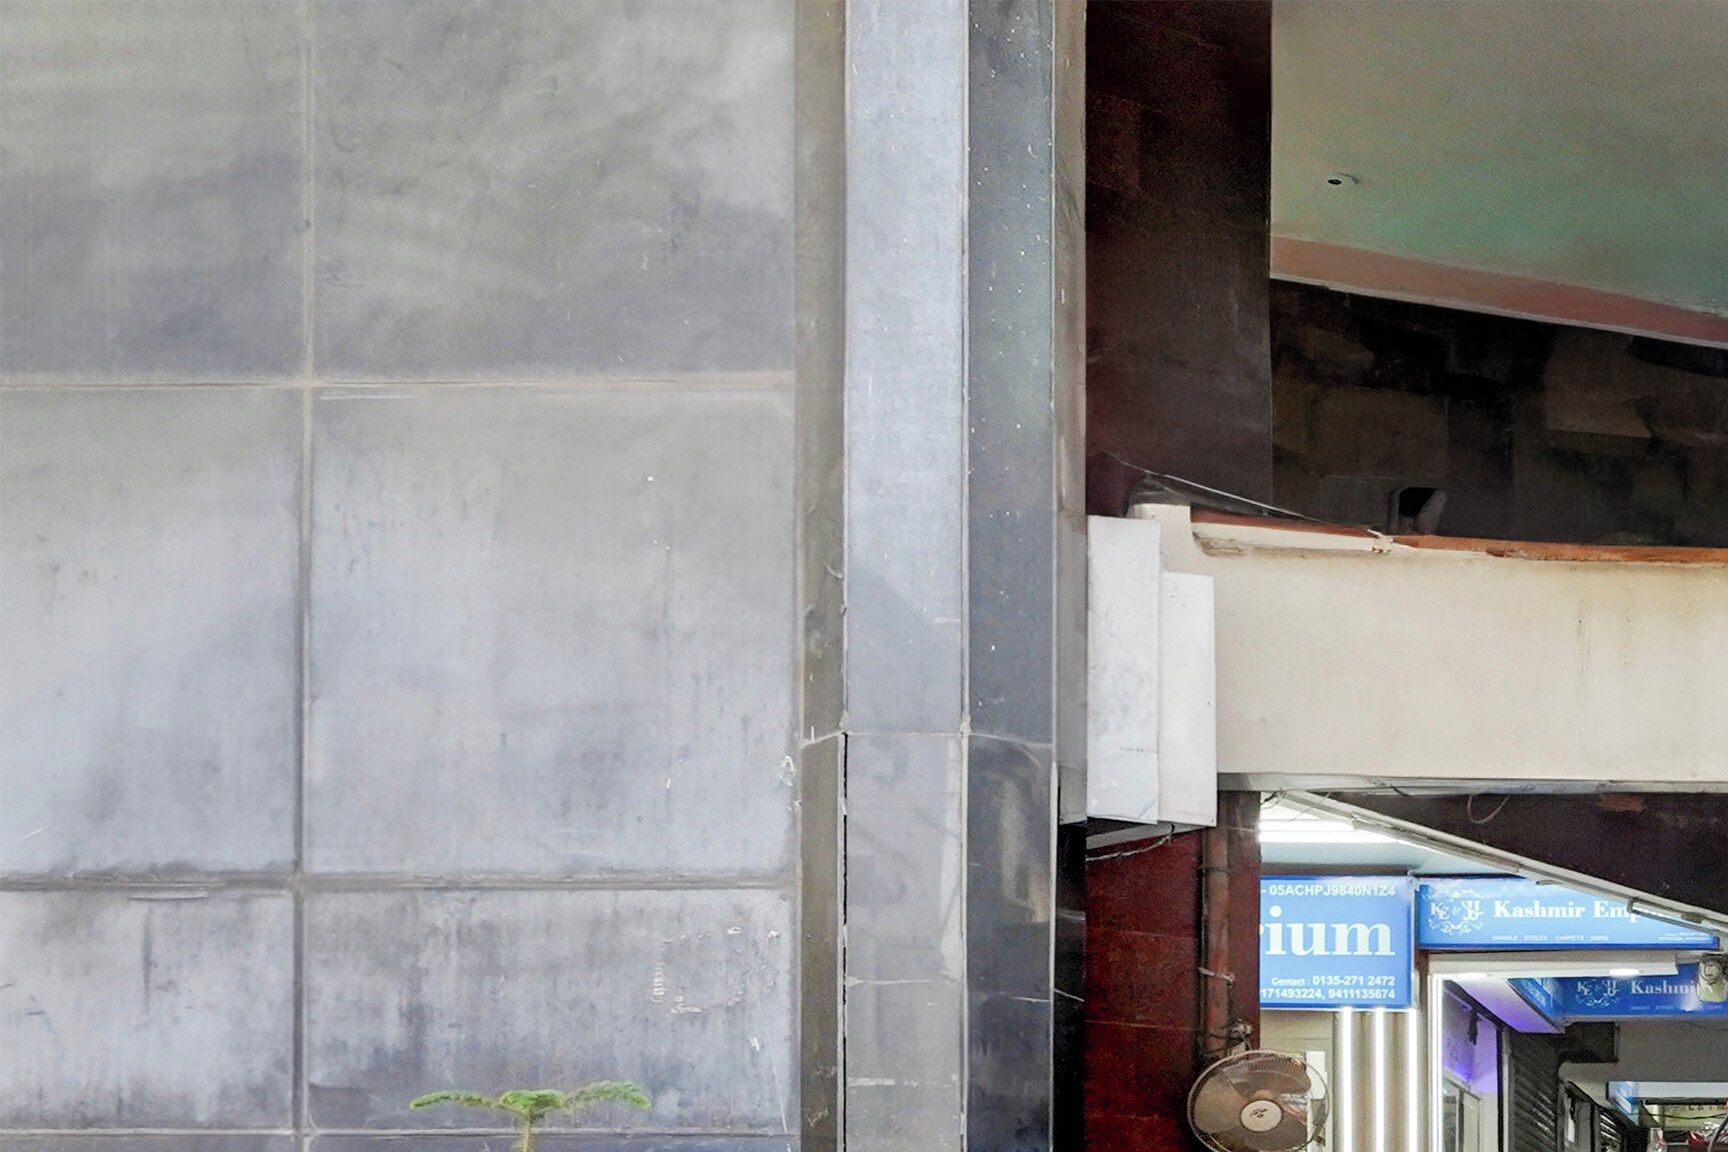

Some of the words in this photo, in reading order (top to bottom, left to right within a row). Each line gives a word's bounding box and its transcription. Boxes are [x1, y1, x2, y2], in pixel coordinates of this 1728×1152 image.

[1493, 900, 1586, 918] Kashmir
[1260, 905, 1395, 956] ium
[1271, 977, 1305, 986] Contact
[1312, 976, 1363, 986] 0135-271
[1369, 976, 1395, 986] 2472
[1630, 980, 1694, 994] Kashmi
[1328, 988, 1395, 999] 9411135674
